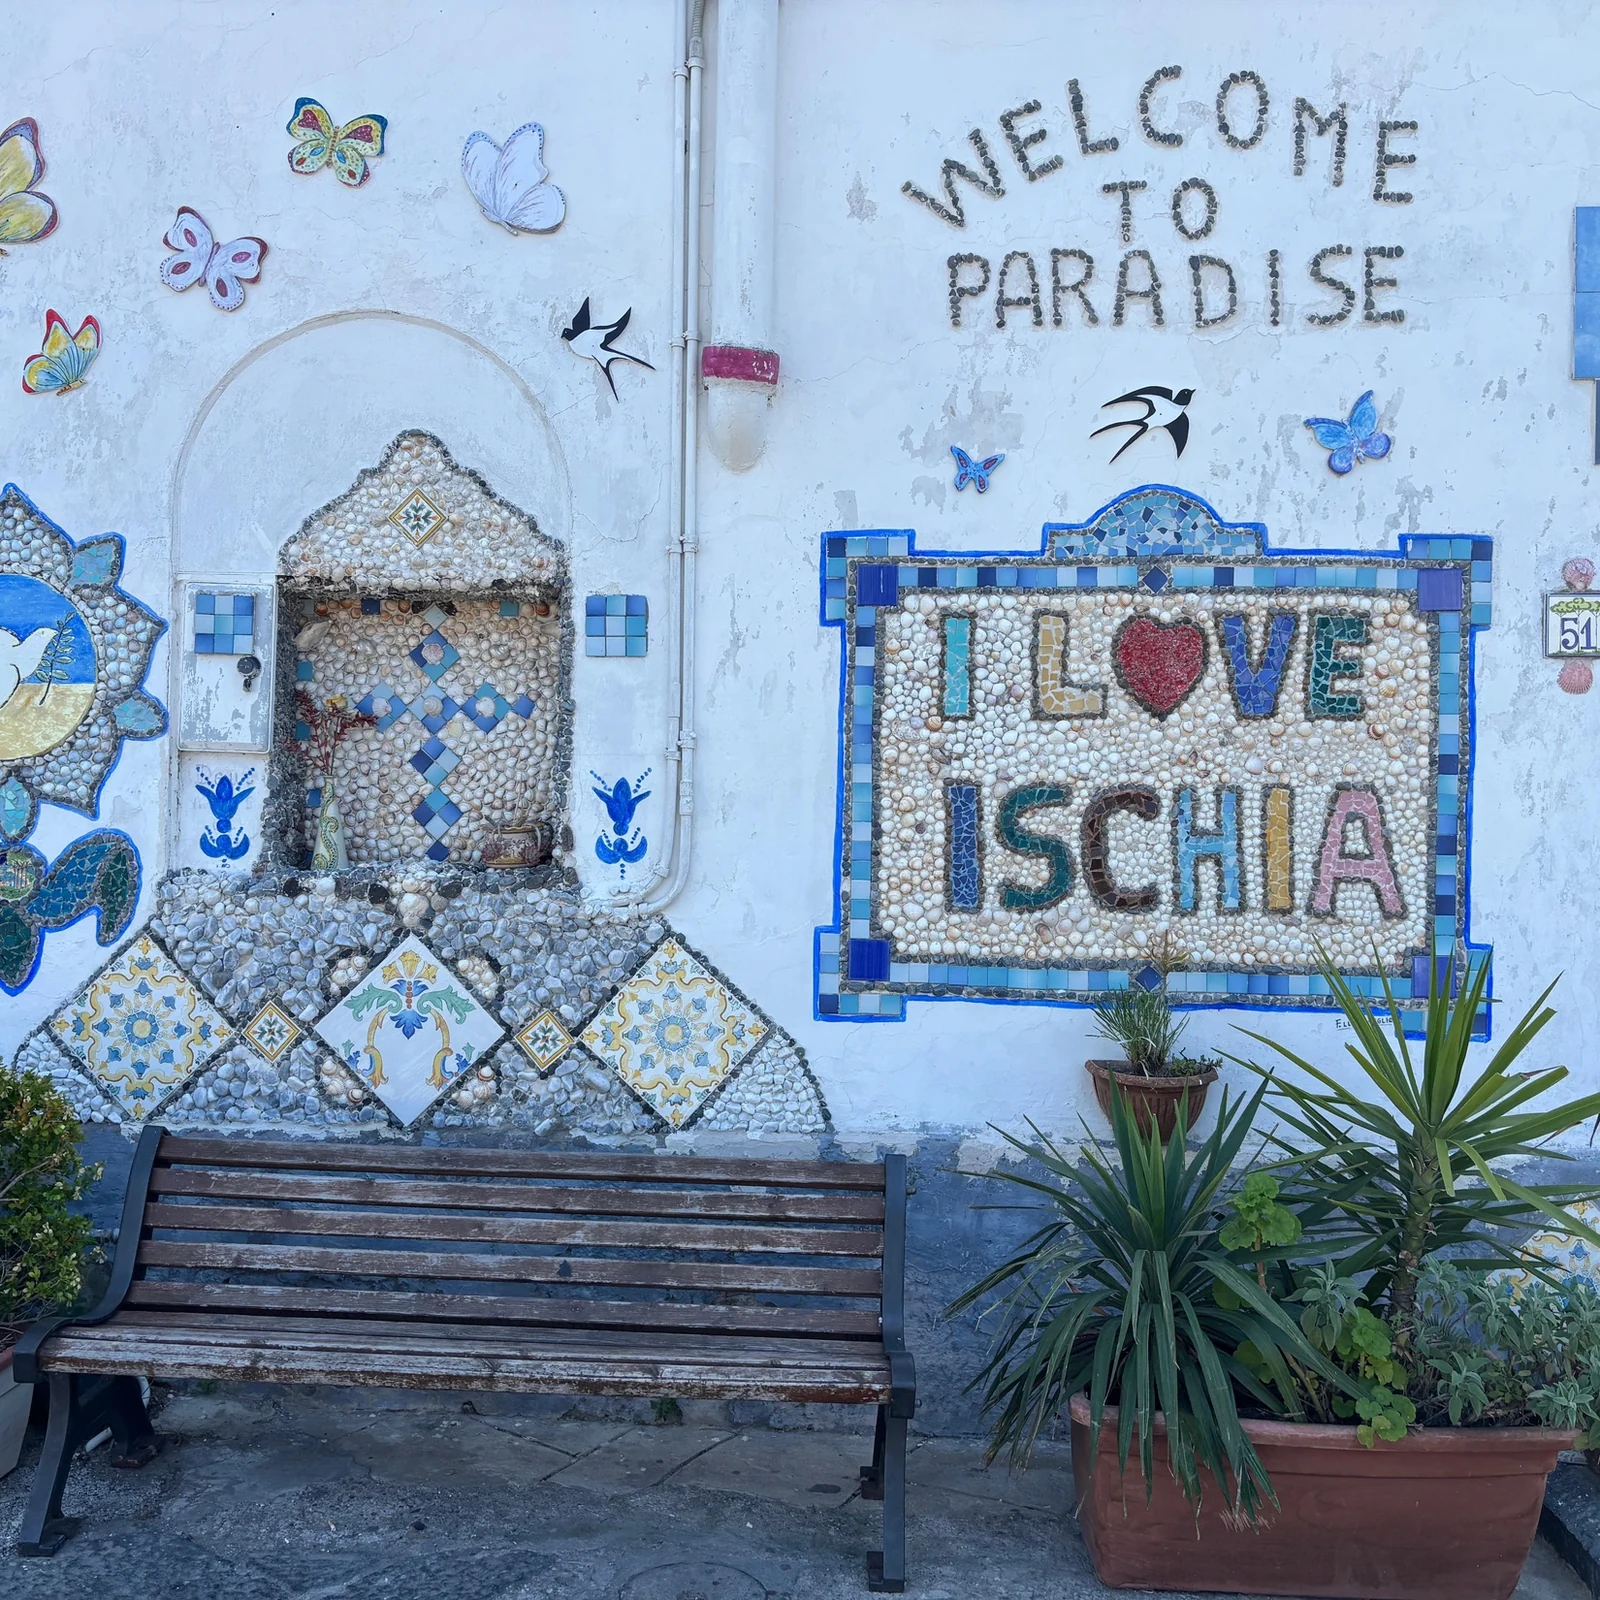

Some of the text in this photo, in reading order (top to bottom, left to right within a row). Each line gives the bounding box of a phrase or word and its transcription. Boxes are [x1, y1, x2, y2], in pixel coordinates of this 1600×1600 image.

[902, 65, 1418, 227] WELCOME
[1102, 177, 1218, 242] TO
[947, 247, 1405, 328] PARADISE
[941, 609, 974, 720] I
[1561, 617, 1597, 650] 51
[945, 779, 1407, 919] ISCHIA
